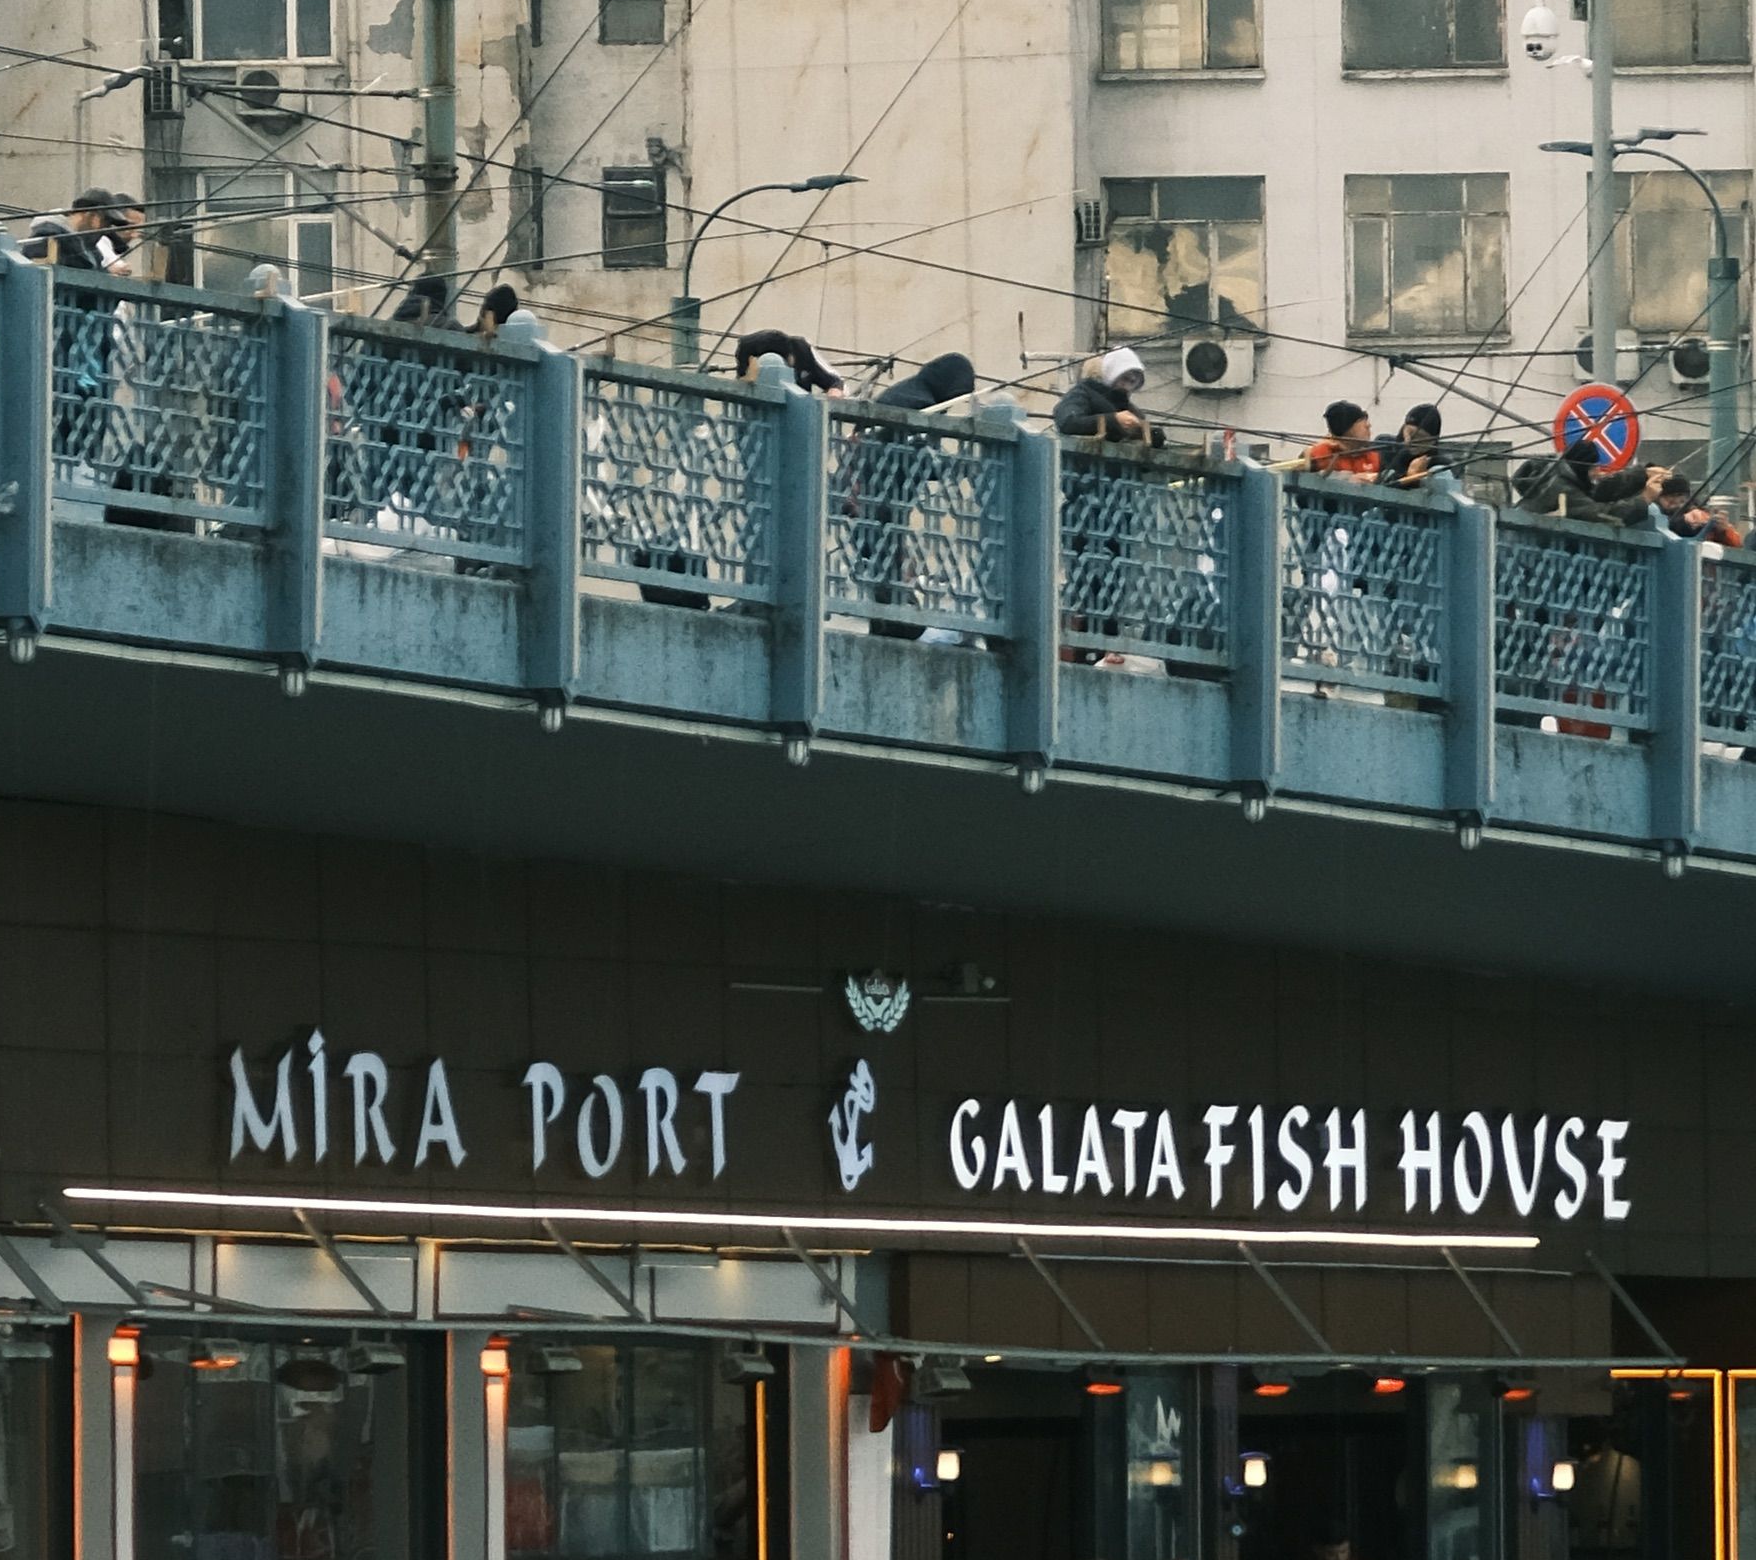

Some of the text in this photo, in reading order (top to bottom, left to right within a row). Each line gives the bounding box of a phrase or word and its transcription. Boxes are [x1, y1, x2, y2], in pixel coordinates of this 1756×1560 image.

[522, 1061, 740, 1179] PORT
[949, 1098, 1185, 1200] GALATA
[1202, 1105, 1367, 1213] FISH
